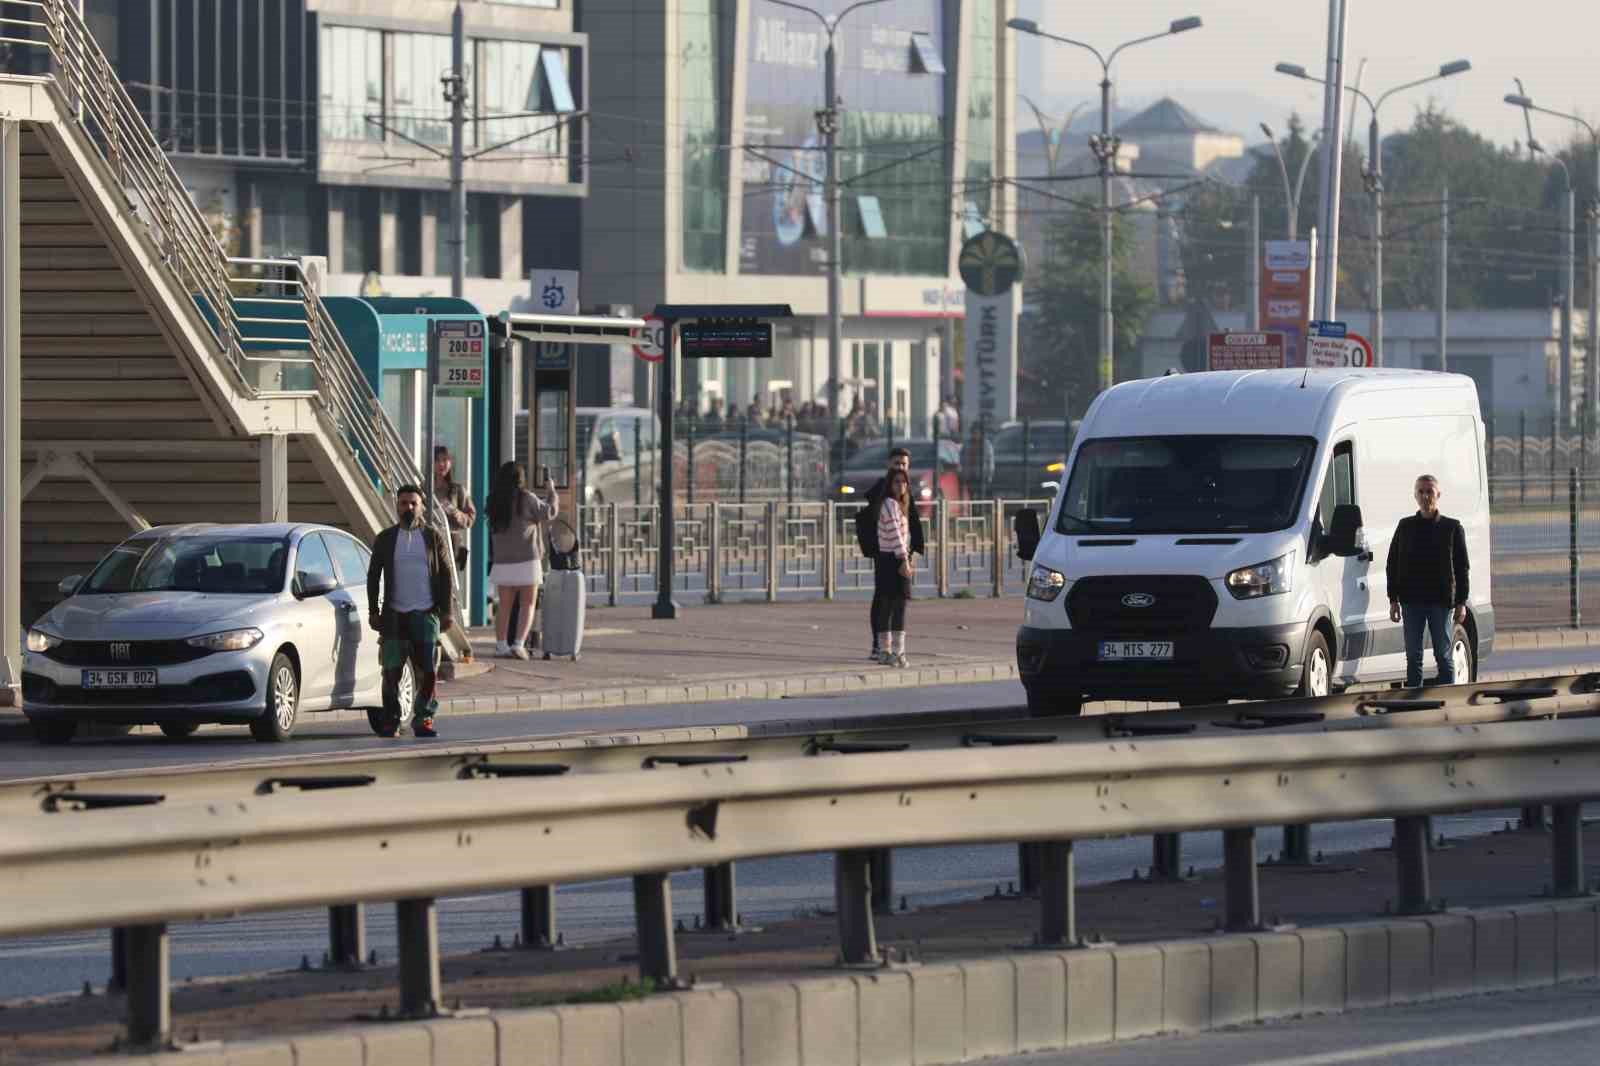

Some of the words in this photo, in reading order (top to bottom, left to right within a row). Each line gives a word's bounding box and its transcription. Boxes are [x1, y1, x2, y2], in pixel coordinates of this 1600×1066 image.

[469, 322, 481, 337] D
[640, 326, 664, 349] 50
[448, 341, 468, 353] 200
[448, 368, 468, 381] 250
[110, 643, 131, 657] FIAT
[1104, 643, 1117, 656] 34
[1150, 643, 1170, 656] 277
[89, 671, 102, 684] 34
